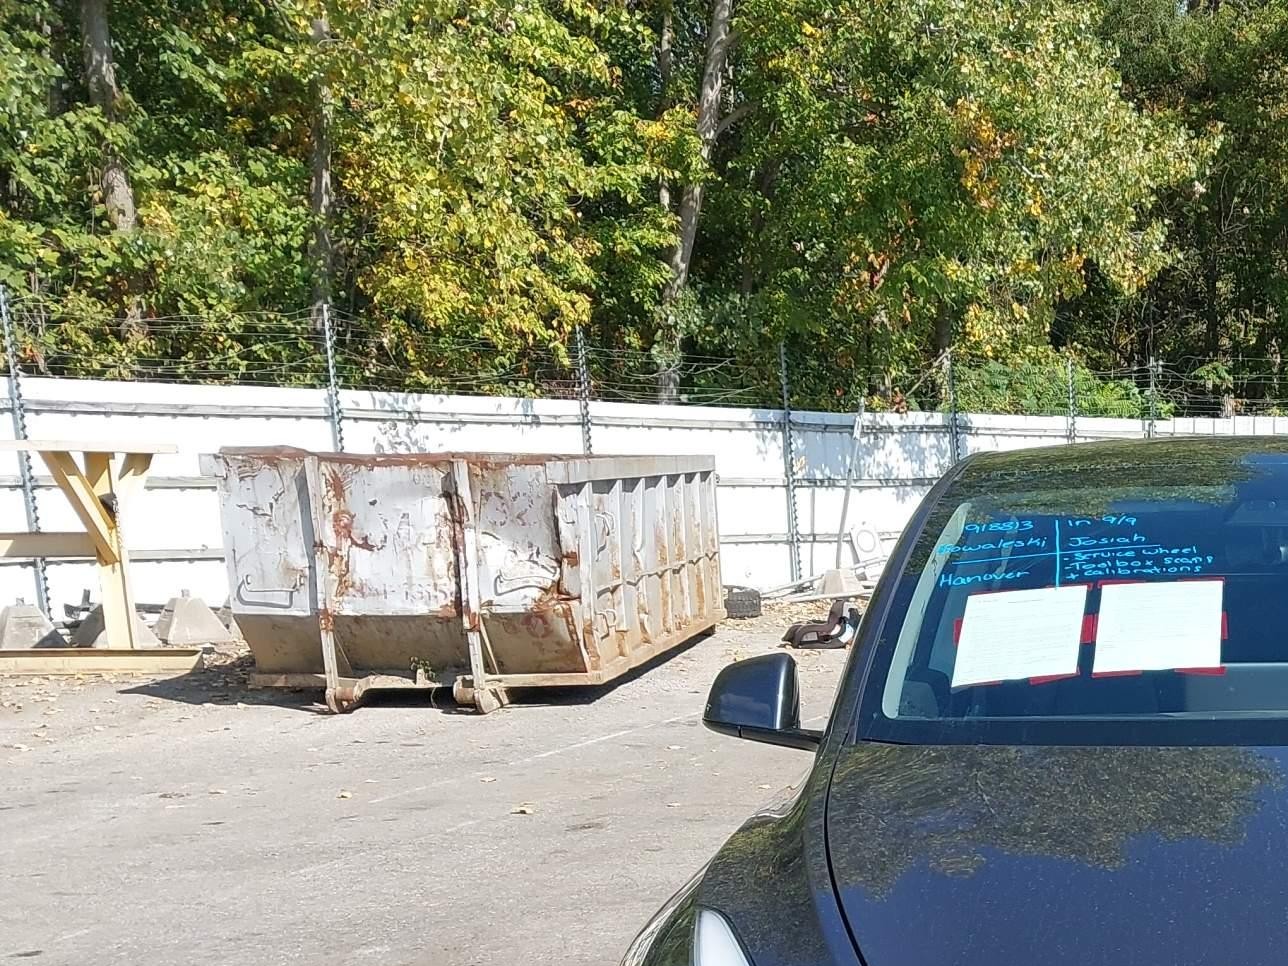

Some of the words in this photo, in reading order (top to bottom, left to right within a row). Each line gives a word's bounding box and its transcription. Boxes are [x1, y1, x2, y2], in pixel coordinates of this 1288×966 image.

[1101, 515, 1137, 526] 9/9
[1068, 533, 1146, 547] Josiah
[1141, 545, 1197, 555] wheel
[940, 570, 1030, 587] Hanover
